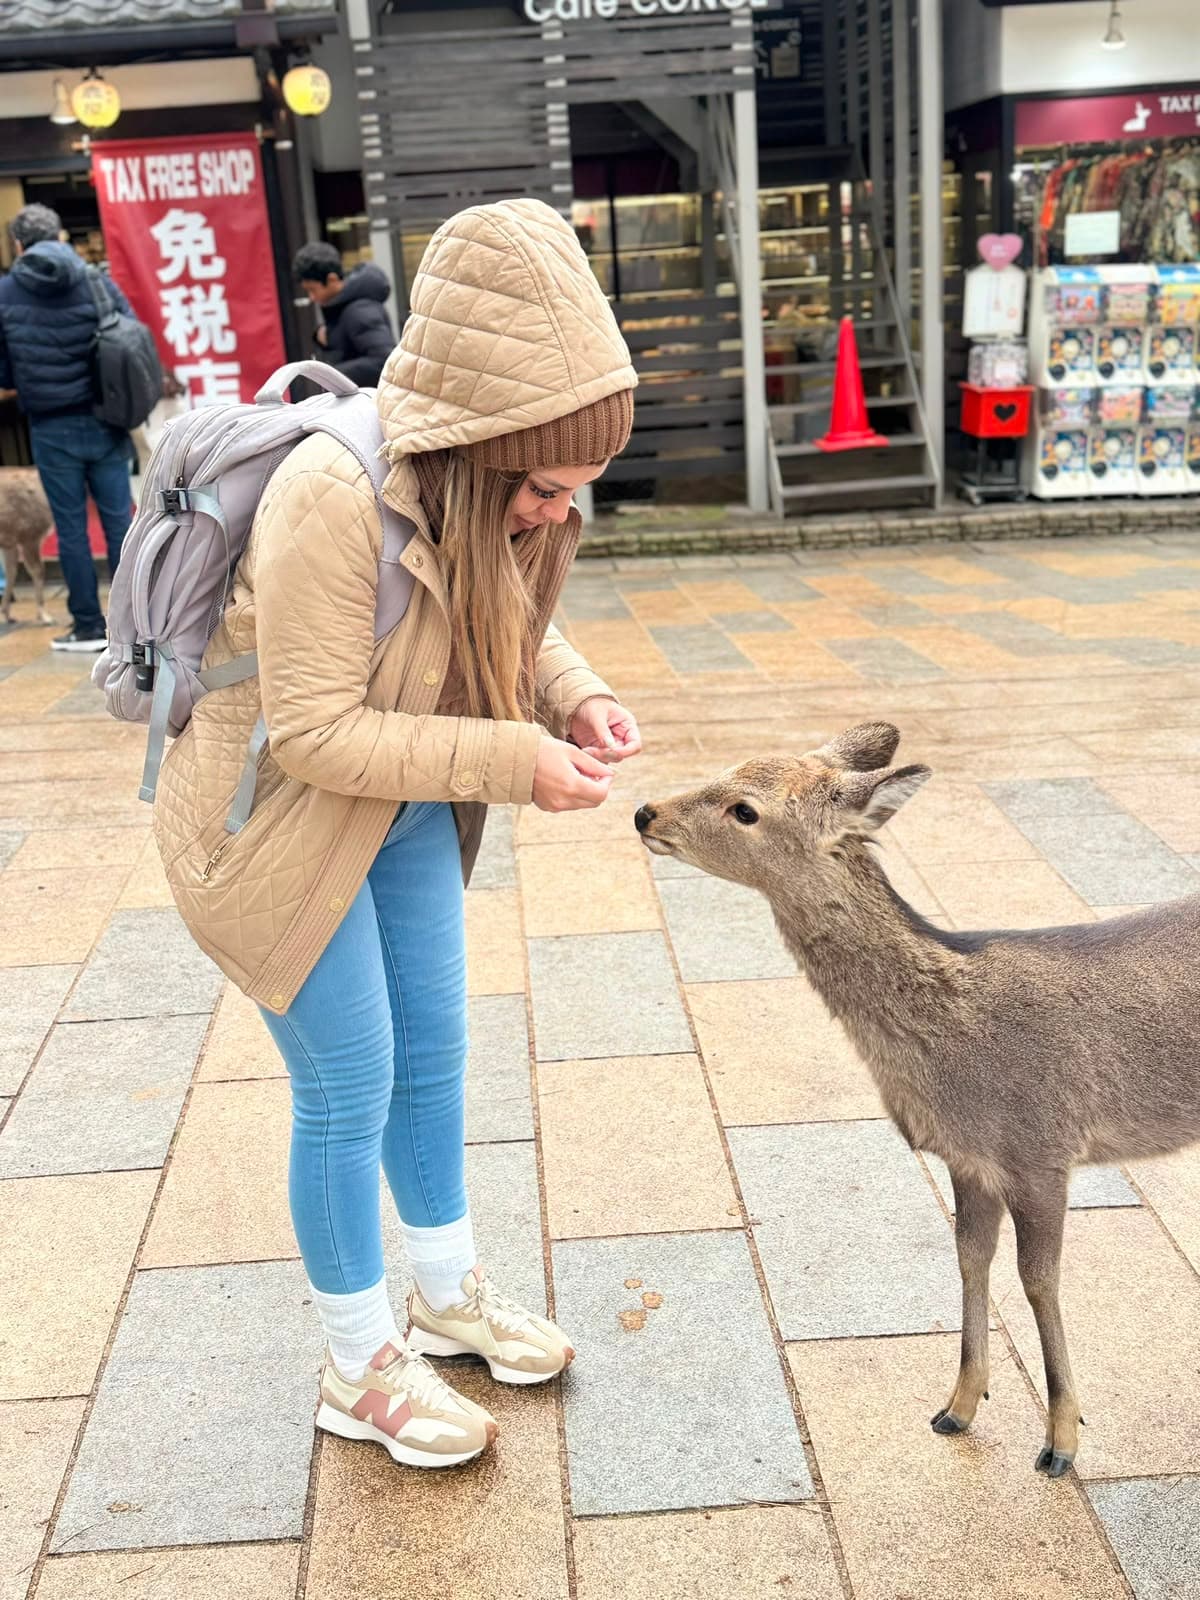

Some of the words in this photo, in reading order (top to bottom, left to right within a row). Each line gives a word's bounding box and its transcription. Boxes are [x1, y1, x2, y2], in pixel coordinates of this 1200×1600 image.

[1159, 95, 1192, 113] TAX
[100, 157, 146, 203] TAX
[145, 153, 198, 201] FREE
[199, 149, 255, 197] SHOP
[150, 208, 241, 412] 免税店
